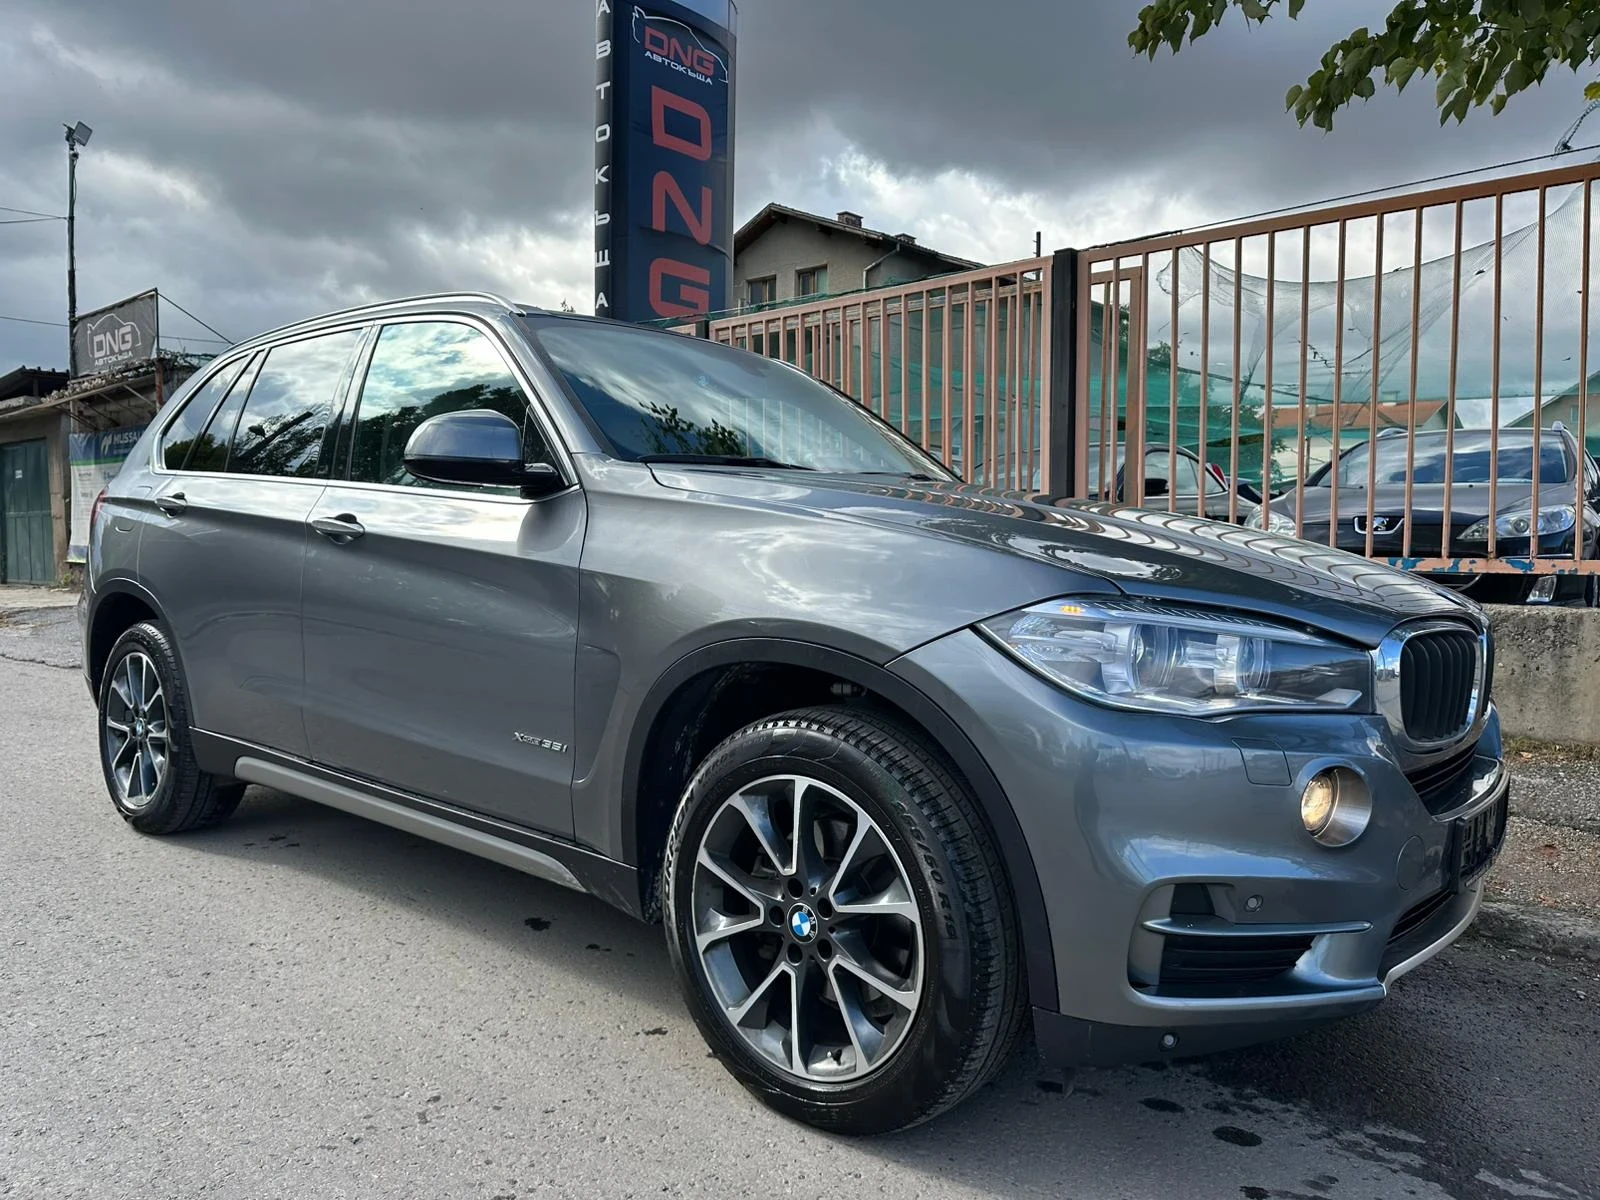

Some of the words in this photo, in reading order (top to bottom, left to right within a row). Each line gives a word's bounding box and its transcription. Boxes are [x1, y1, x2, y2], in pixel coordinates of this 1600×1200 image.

[645, 26, 715, 77] DNG
[649, 85, 712, 321] DNG
[94, 325, 132, 358] DNG
